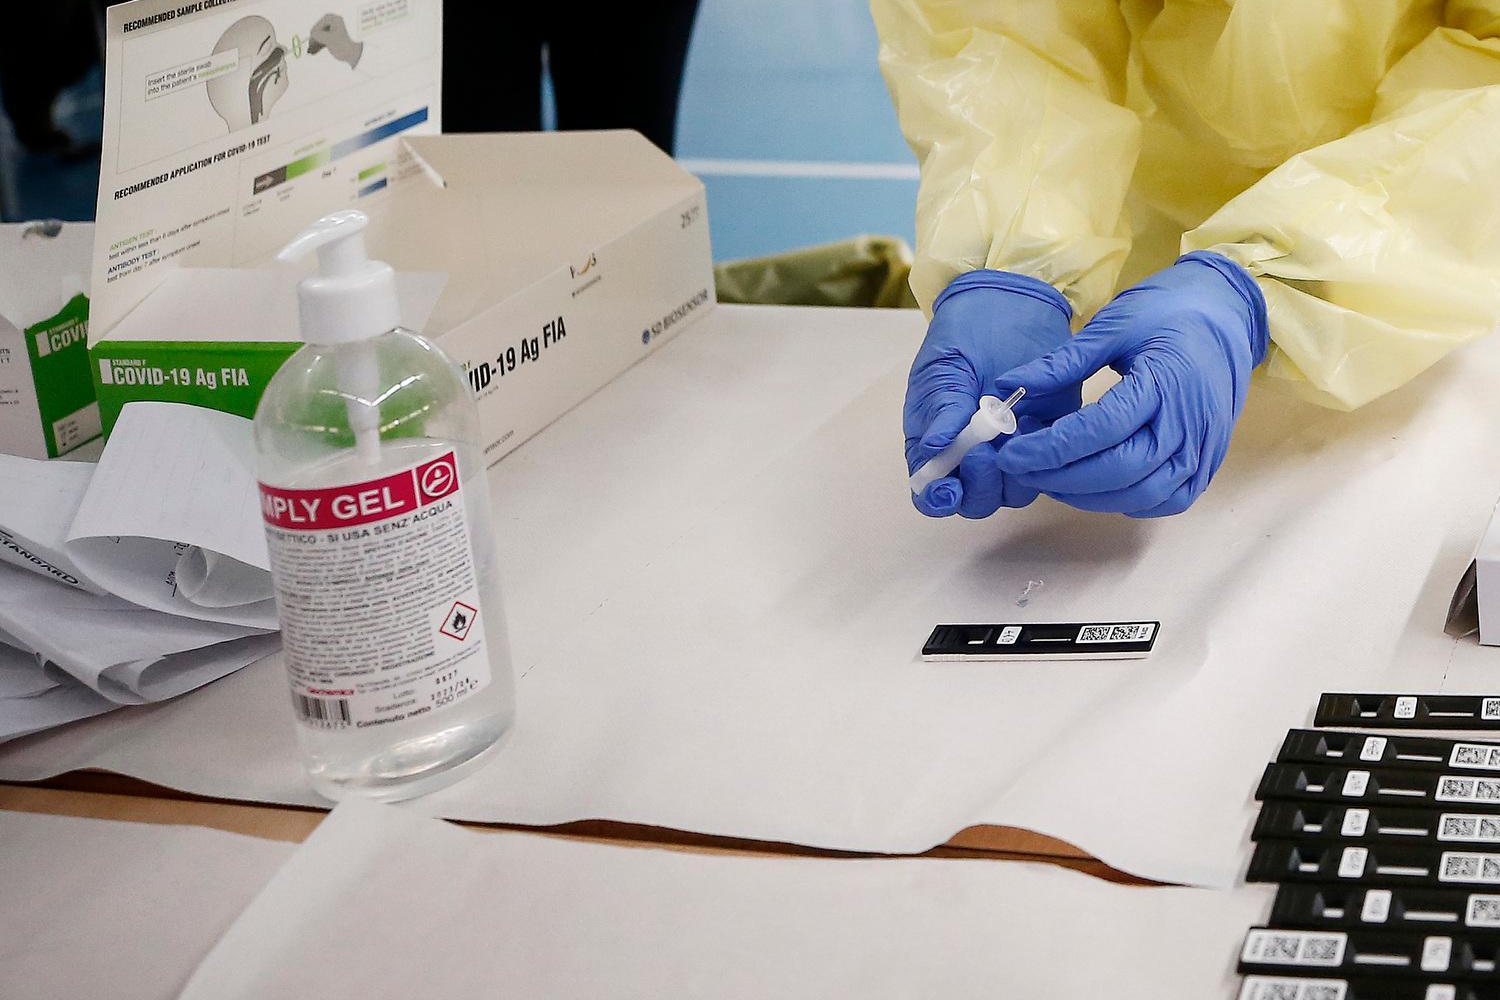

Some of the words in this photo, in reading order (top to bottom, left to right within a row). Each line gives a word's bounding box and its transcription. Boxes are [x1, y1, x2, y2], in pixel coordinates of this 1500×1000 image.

[124, 12, 175, 33] RECOMMENDED
[177, 2, 202, 17] SAMPLE
[114, 173, 169, 200] RECOMMENDED
[170, 157, 213, 181] APPLICATION
[213, 152, 227, 164] FOR
[227, 139, 256, 158] COVID-19
[256, 134, 271, 147] TEST
[107, 256, 140, 274] ANTIBODY
[141, 250, 157, 262] TEST
[50, 319, 88, 352] COVI
[521, 338, 539, 364] Ag
[543, 316, 566, 348] FIA
[112, 367, 190, 386] COVID-19
[195, 368, 217, 390] Ag
[221, 368, 249, 387] FIA
[331, 486, 405, 520] GEL
[342, 529, 370, 541] USA
[0, 538, 78, 584] TANDARD
